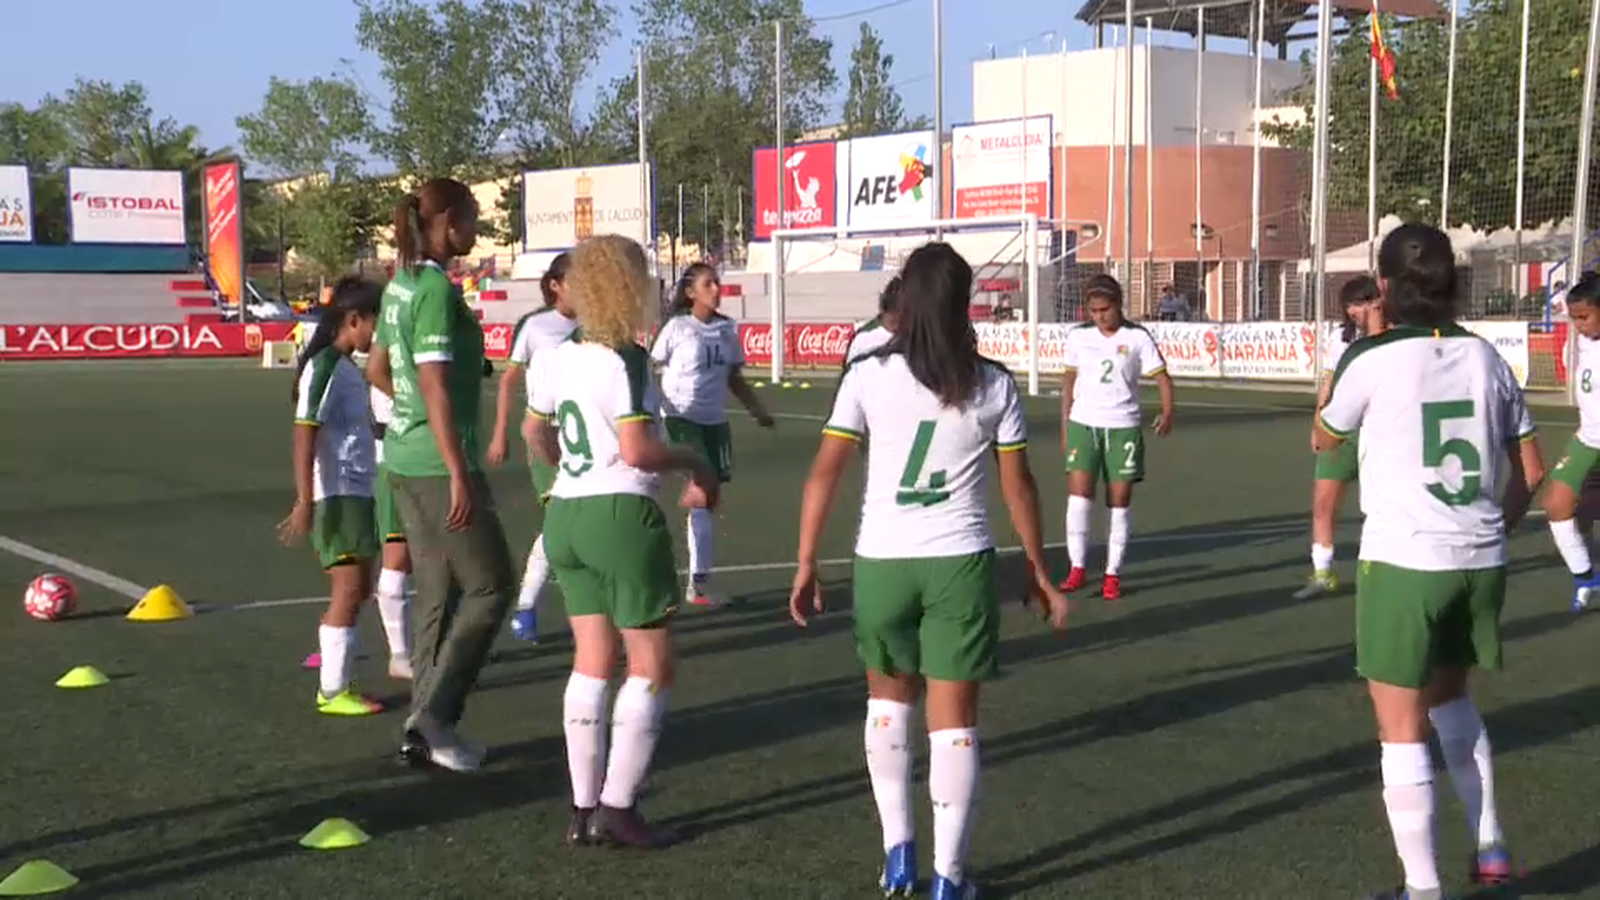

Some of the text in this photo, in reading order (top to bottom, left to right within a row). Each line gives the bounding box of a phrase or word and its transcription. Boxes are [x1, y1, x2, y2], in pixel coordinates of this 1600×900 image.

[855, 176, 897, 206] AFE
[87, 197, 181, 211] ISTOBAL
[706, 343, 725, 368] 14
[1222, 342, 1299, 361] NARANJA
[1100, 359, 1114, 384] 2
[1581, 368, 1592, 393] 8
[559, 400, 594, 478] 9
[896, 420, 950, 507] 4
[1123, 441, 1136, 467] 2
[1421, 400, 1481, 507] 5
